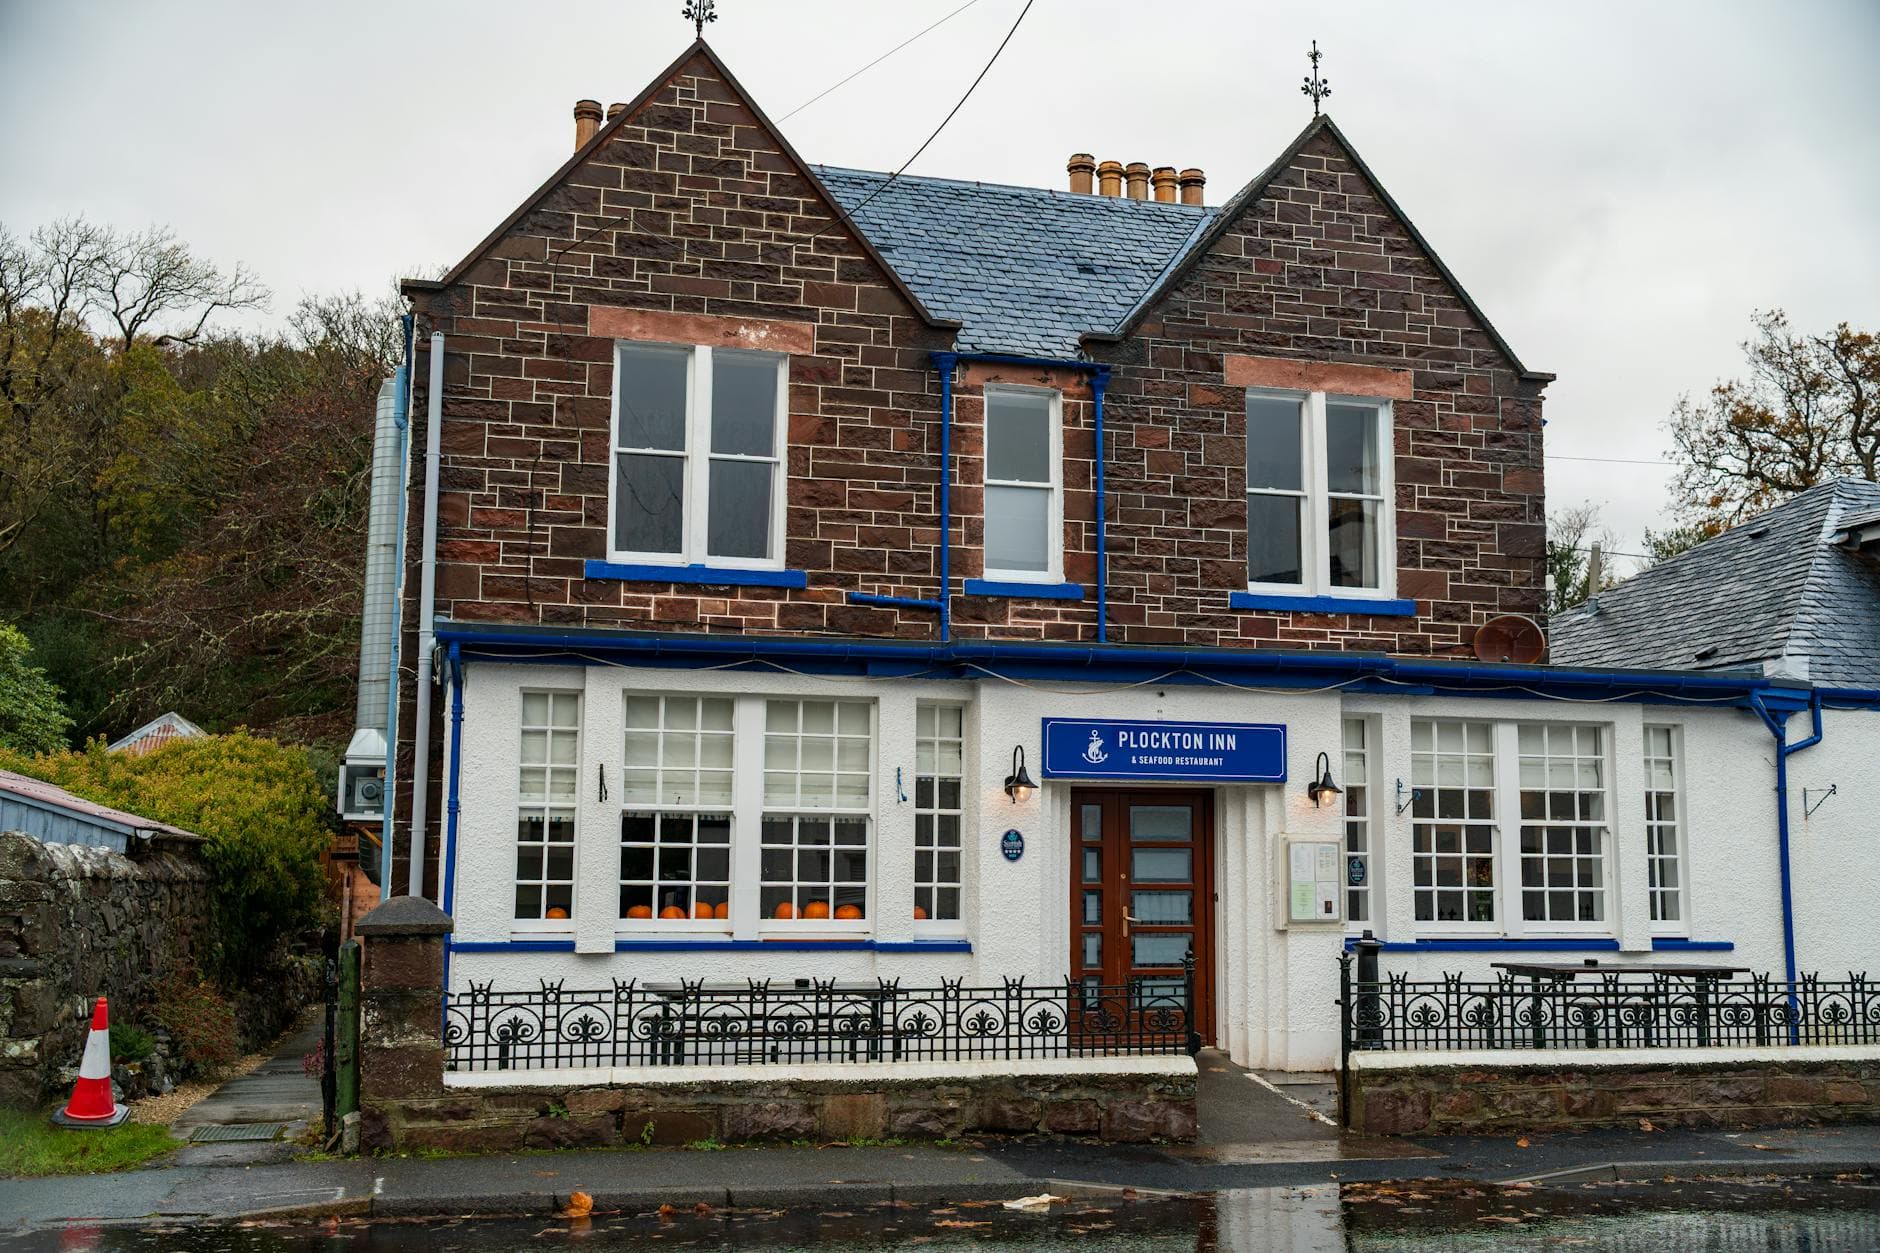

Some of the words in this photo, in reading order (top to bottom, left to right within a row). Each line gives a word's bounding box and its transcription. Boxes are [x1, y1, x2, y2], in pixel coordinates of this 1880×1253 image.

[1118, 731, 1203, 750] PLOCKTON
[1209, 733, 1236, 751] INN
[1131, 755, 1137, 764] &
[1139, 755, 1173, 765] SEAFOOD
[1175, 756, 1223, 766] RESTAURANT
